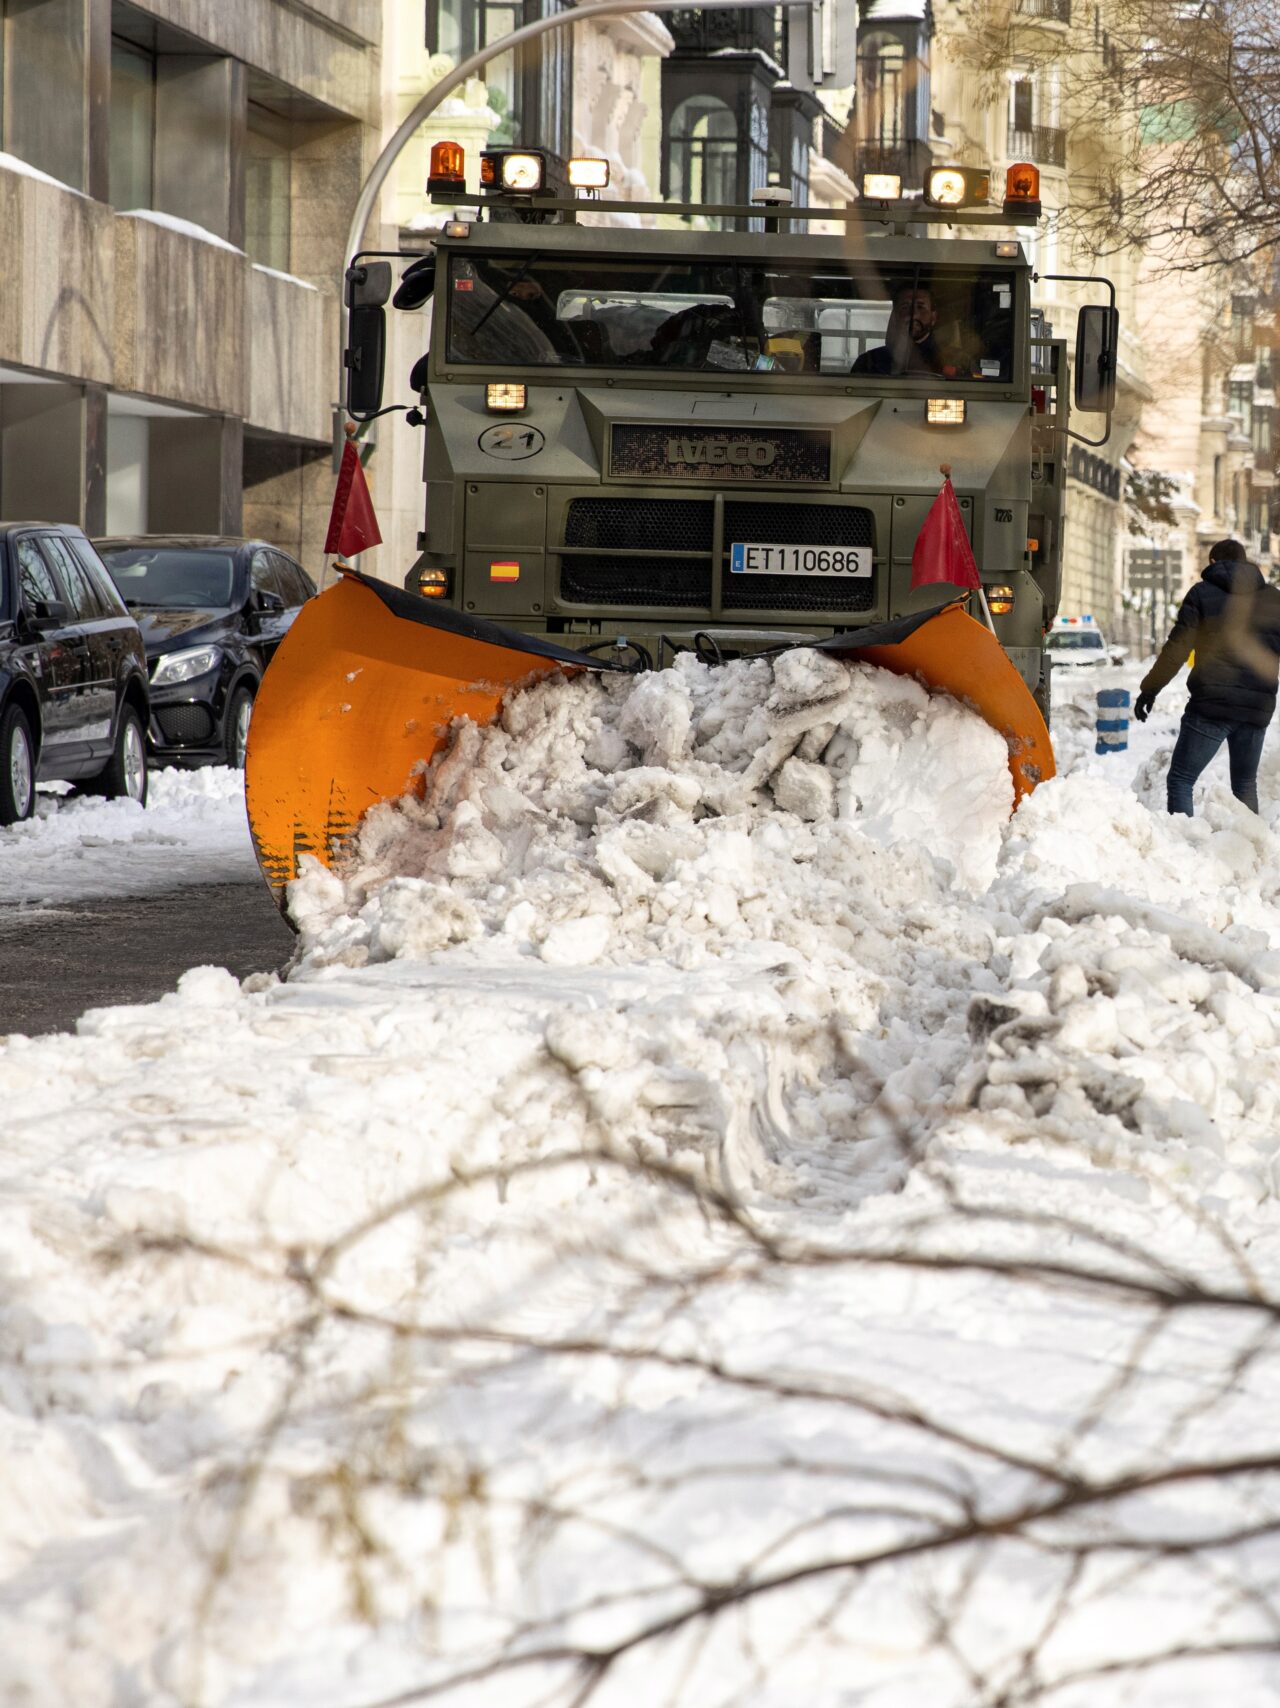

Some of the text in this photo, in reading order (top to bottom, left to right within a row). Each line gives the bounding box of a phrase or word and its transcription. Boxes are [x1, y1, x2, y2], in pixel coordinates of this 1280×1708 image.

[491, 430, 535, 450] 21
[668, 439, 776, 466] IVECO
[747, 547, 859, 573] ET110686
